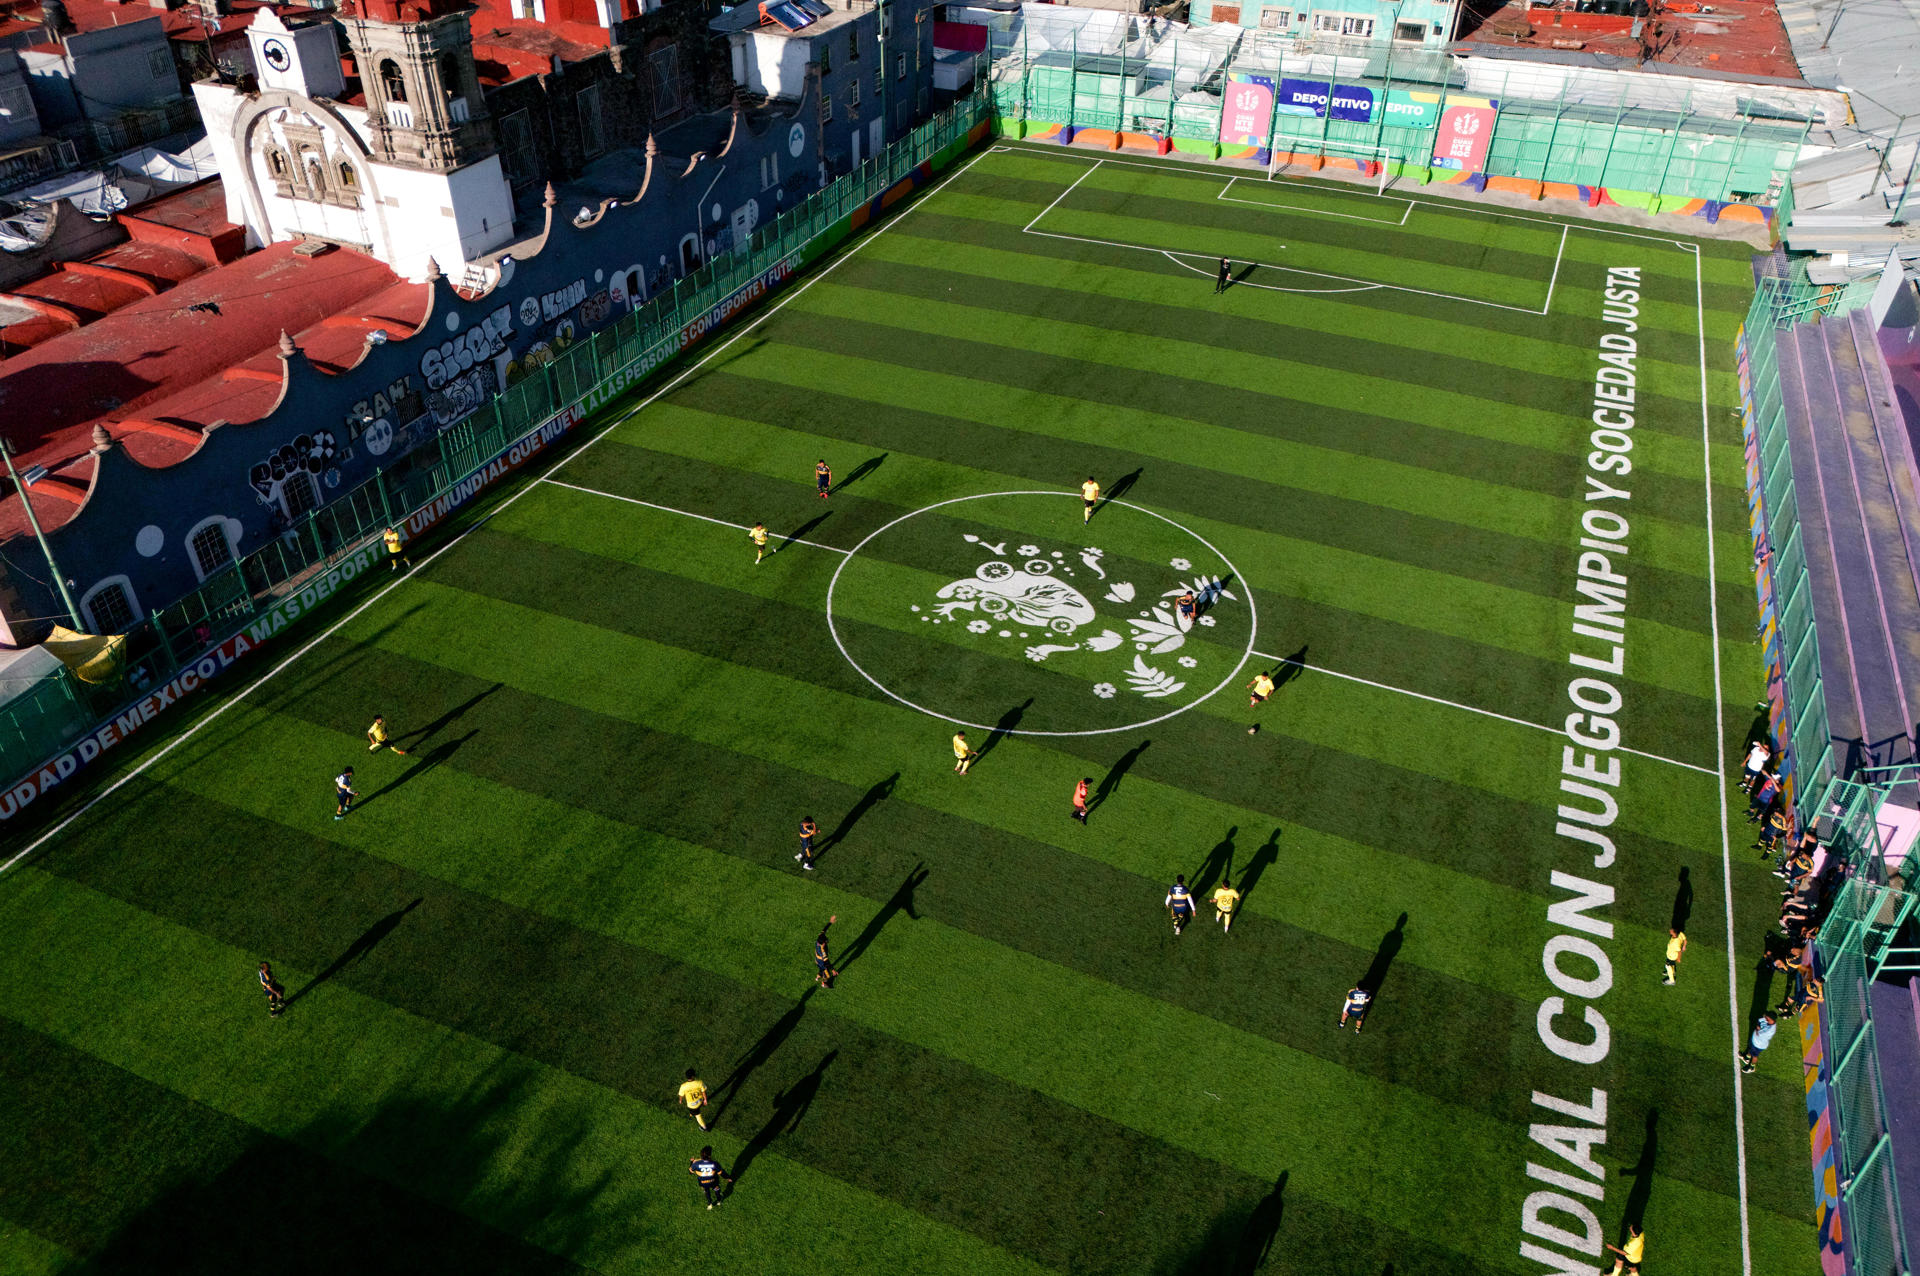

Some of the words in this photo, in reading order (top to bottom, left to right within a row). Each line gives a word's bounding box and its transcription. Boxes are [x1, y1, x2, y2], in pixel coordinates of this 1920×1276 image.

[1292, 92, 1370, 111] DEPORTIVO
[1373, 101, 1424, 116] TEPITO
[1602, 266, 1641, 333] JUSTA
[1588, 334, 1637, 477] SOCIEDAD
[80, 725, 118, 762] DE
[116, 658, 216, 738] MEXICO
[214, 635, 250, 668] LA
[249, 602, 299, 643] MAS
[301, 526, 410, 609] DEPORTIA
[409, 504, 436, 534] UN
[435, 458, 508, 517] MUNDIAL
[510, 432, 542, 465] QUE
[541, 404, 587, 445] MUEVA
[585, 392, 598, 410] A
[598, 380, 625, 403] LAS
[625, 331, 689, 385] PERSONAS
[690, 312, 714, 339] CON
[713, 285, 759, 324] DEPORTE
[758, 275, 767, 290] Y
[1585, 475, 1632, 502] Y
[1569, 510, 1629, 676] LIMPIO
[1555, 678, 1622, 868] JUEGO
[1537, 870, 1615, 1064] CON
